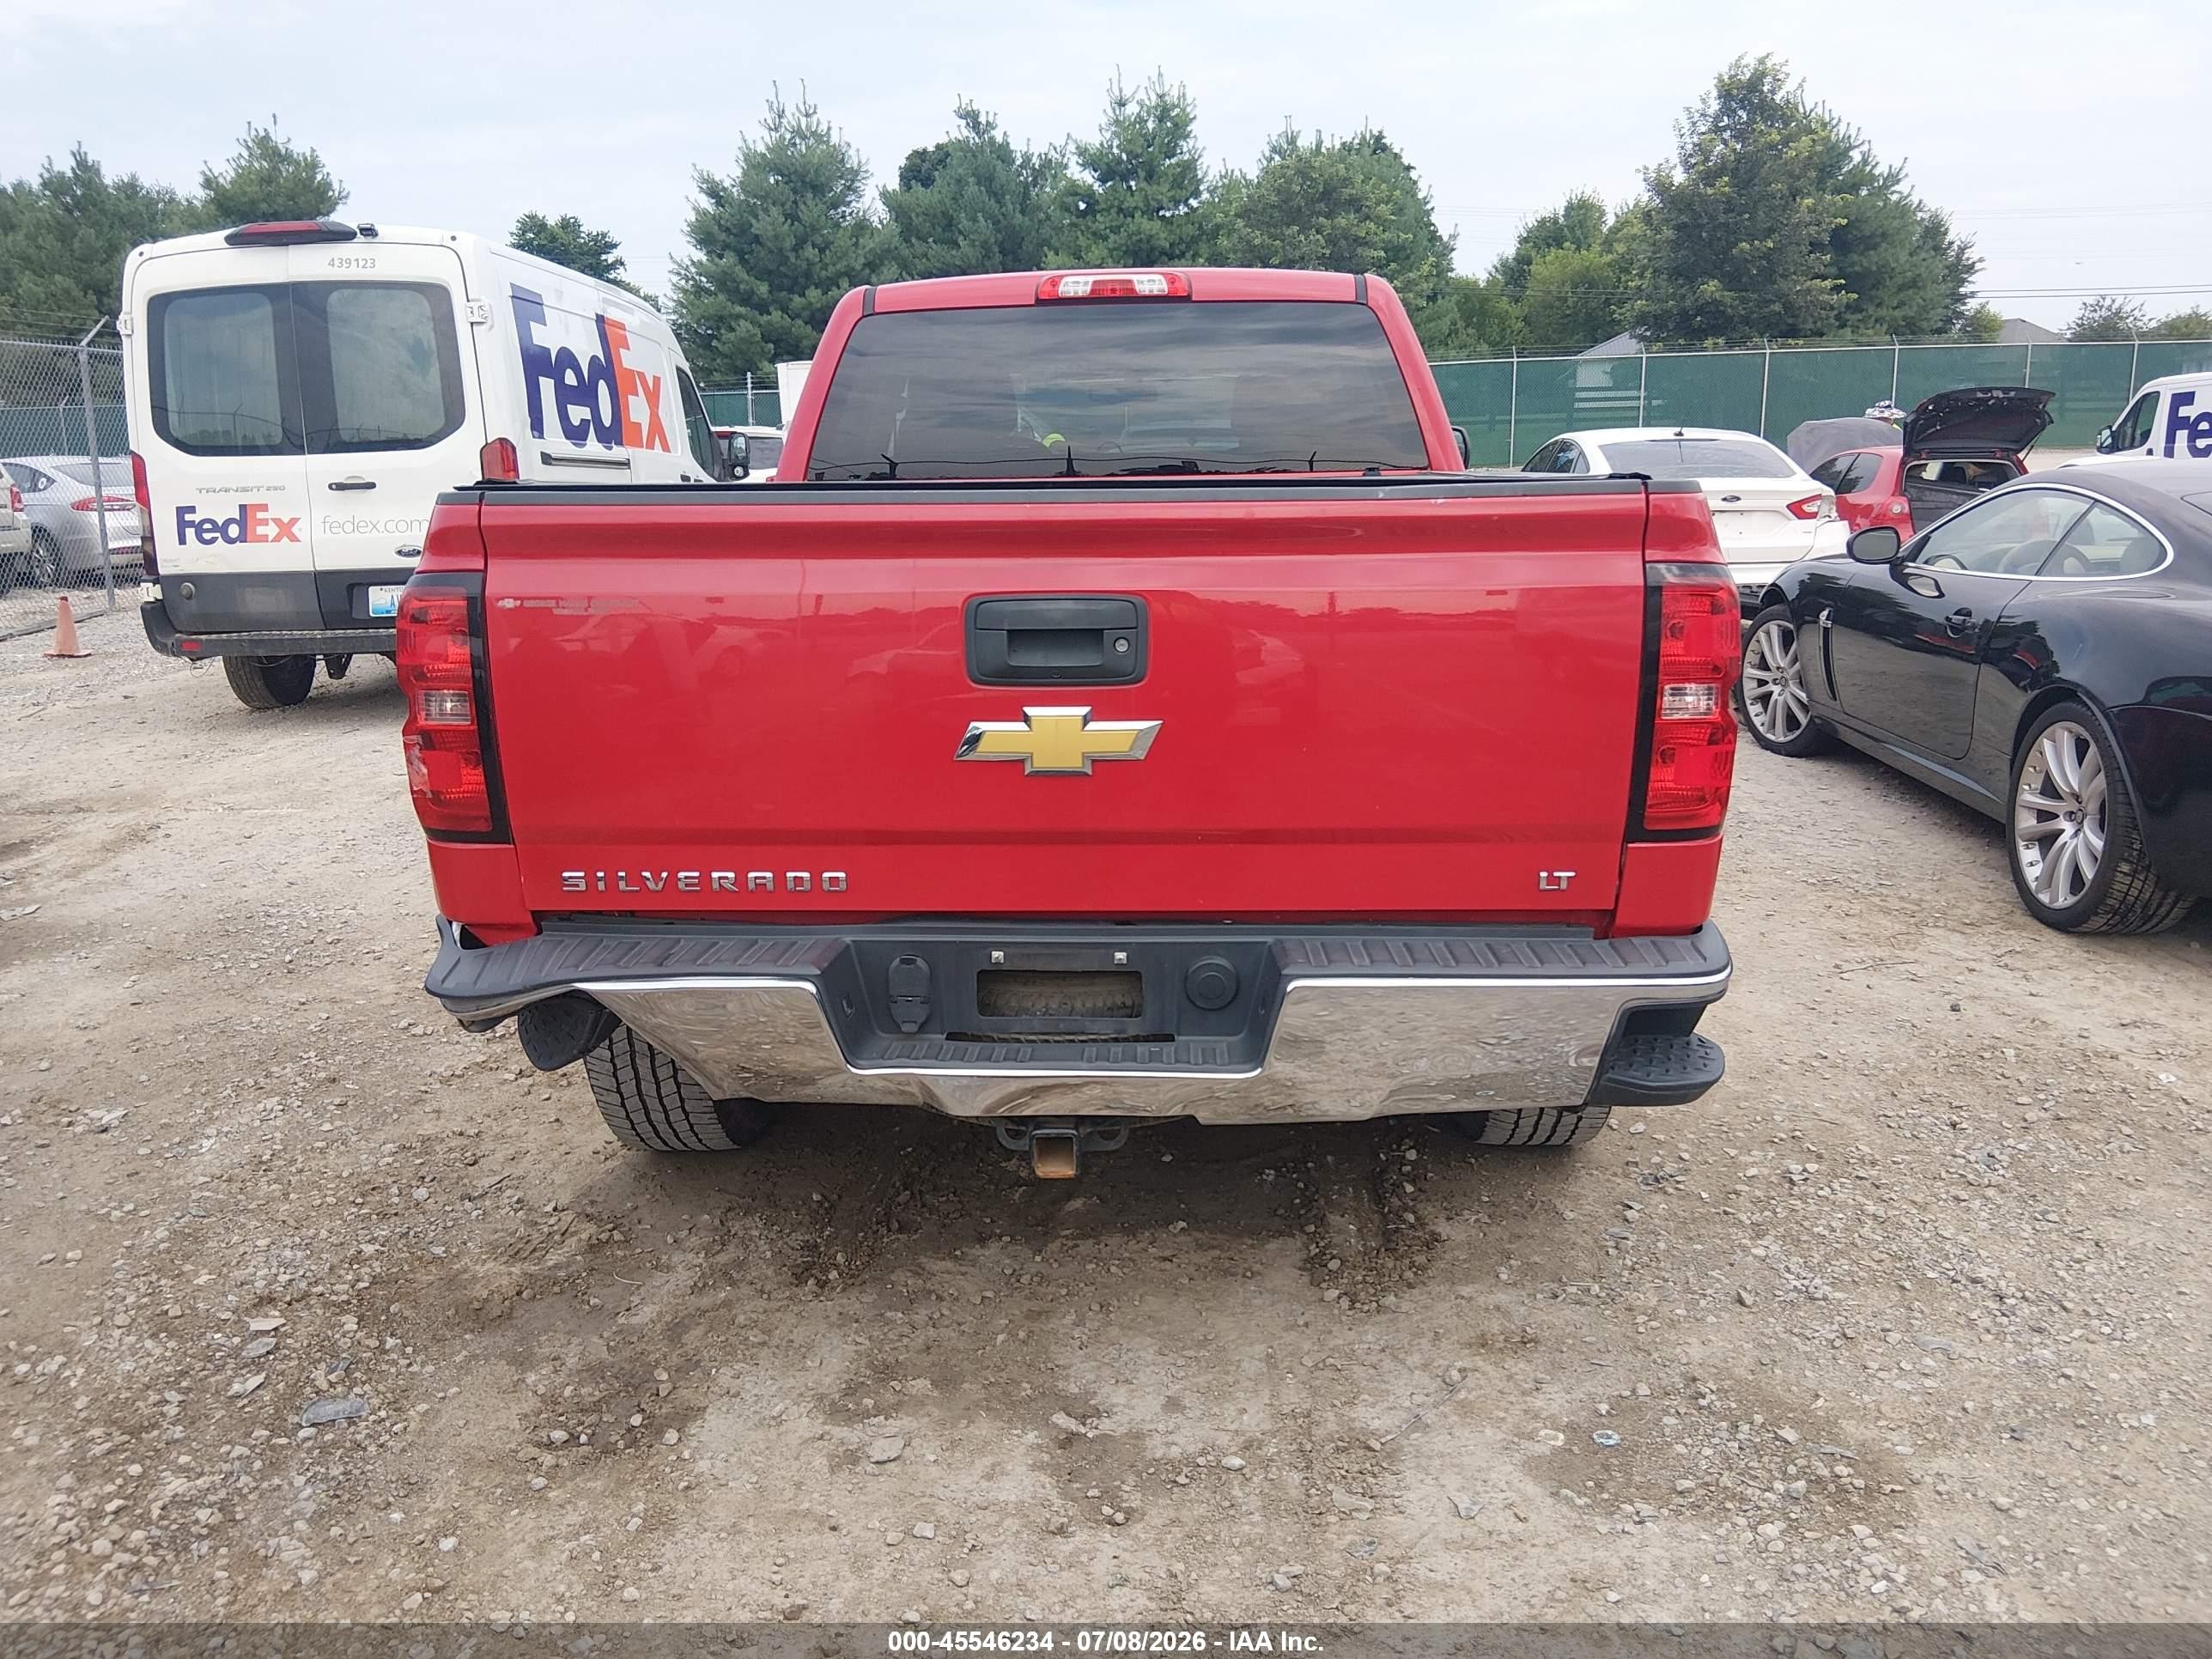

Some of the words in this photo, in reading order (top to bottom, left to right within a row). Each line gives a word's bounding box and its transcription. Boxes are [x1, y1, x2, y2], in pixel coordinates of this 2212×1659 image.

[328, 258, 376, 269] 439123
[510, 282, 672, 451] FedEx
[2163, 391, 2212, 459] Fe
[196, 485, 264, 494] TRANSIT
[175, 503, 301, 545] FedEx
[321, 515, 430, 534] fedex.com
[562, 871, 848, 893] SILVERADO
[1539, 872, 1577, 890] LT
